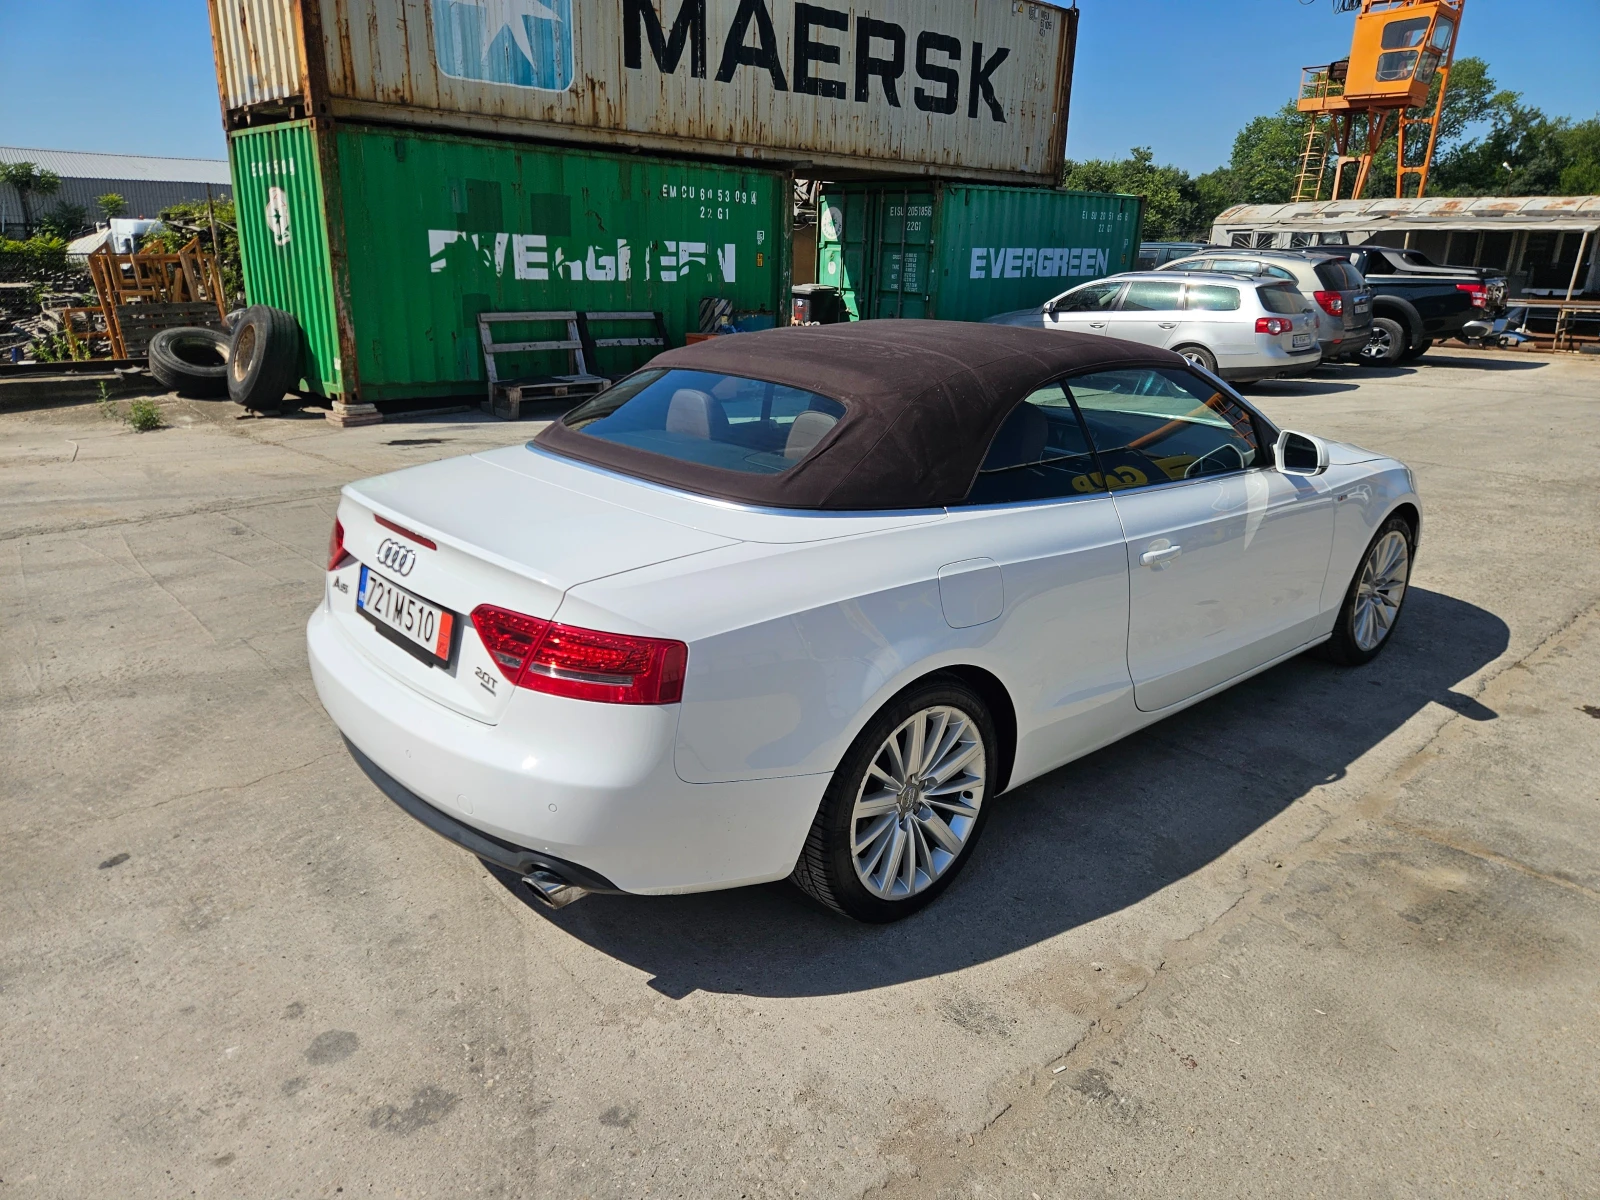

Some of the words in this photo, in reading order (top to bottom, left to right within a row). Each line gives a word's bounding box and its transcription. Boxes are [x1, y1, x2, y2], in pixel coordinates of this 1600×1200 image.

[624, 0, 1010, 124] MAERSK
[662, 184, 695, 199] EMCU
[969, 247, 1110, 279] EVERGREEN
[333, 575, 349, 595] A5
[366, 576, 435, 643] 721M510
